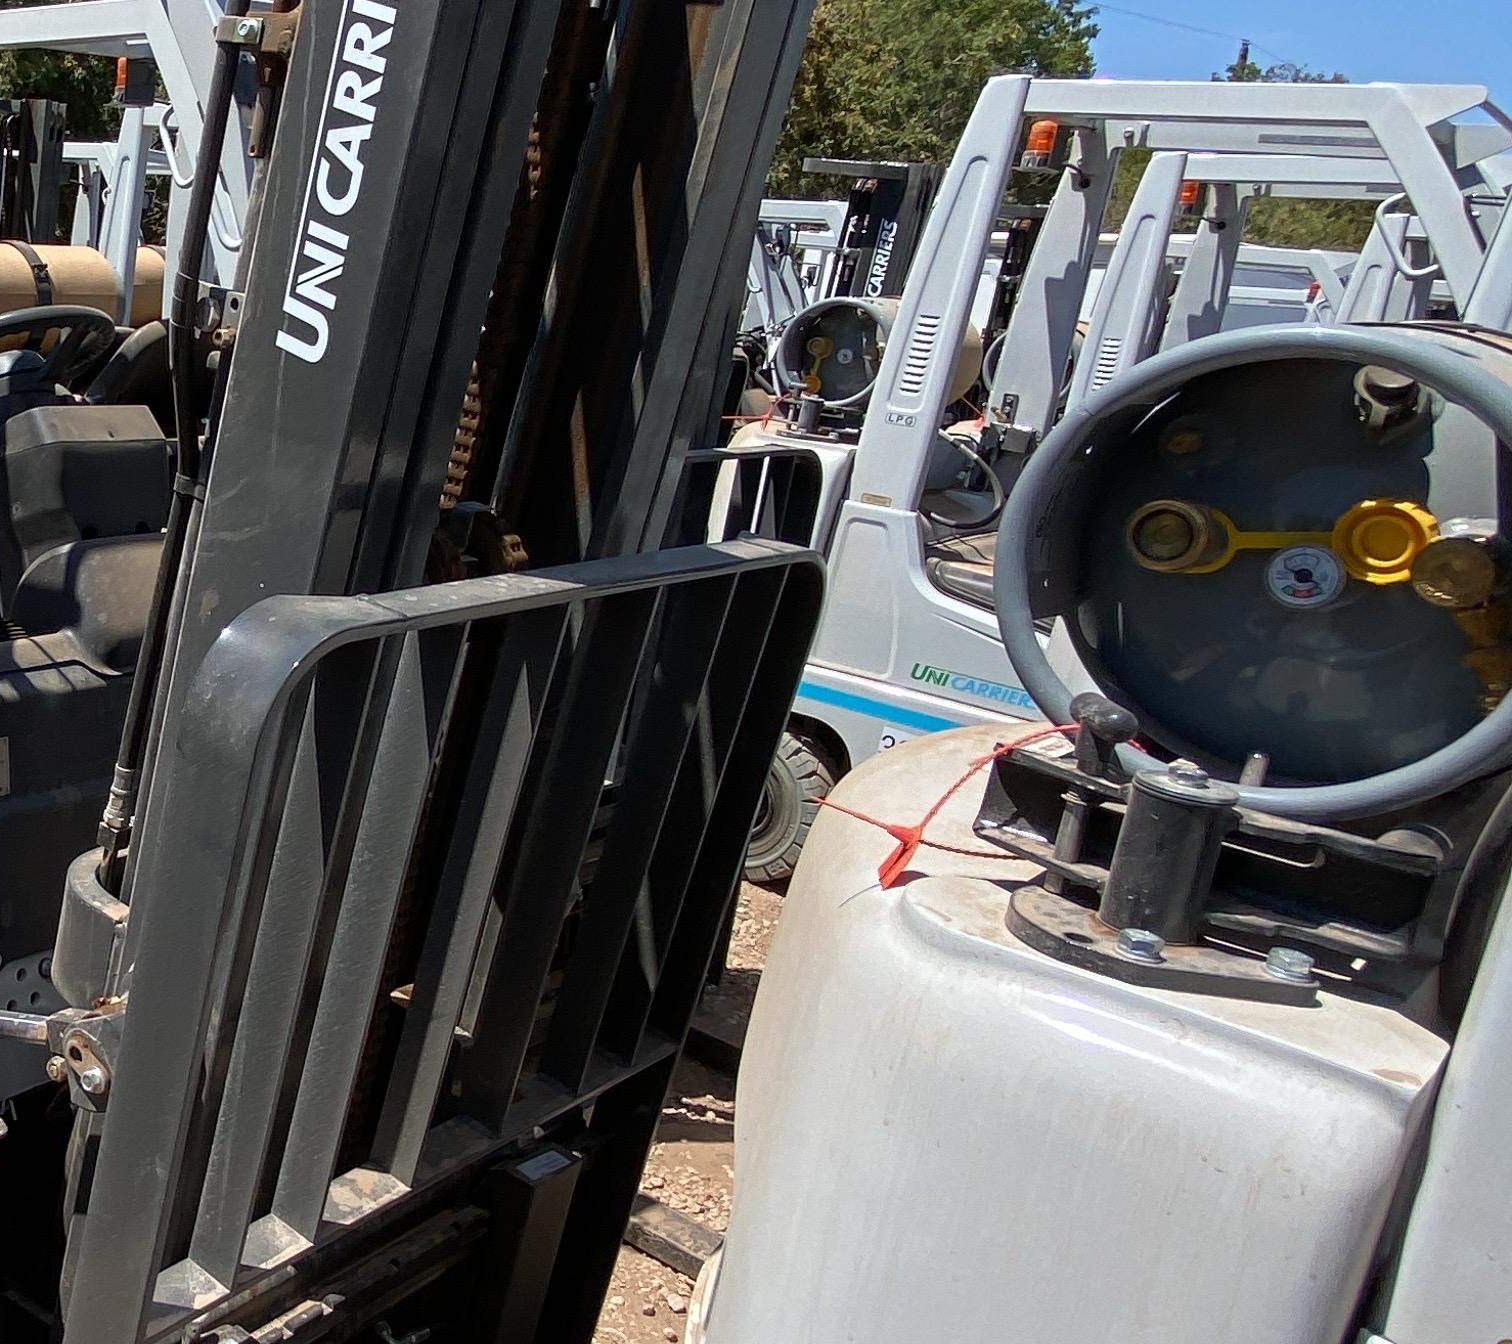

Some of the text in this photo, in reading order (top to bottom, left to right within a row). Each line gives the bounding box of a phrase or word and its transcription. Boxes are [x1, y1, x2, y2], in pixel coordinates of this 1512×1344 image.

[867, 218, 898, 297] CARRIERS
[888, 413, 915, 425] LPG
[910, 662, 1038, 710] UNICARRIER
